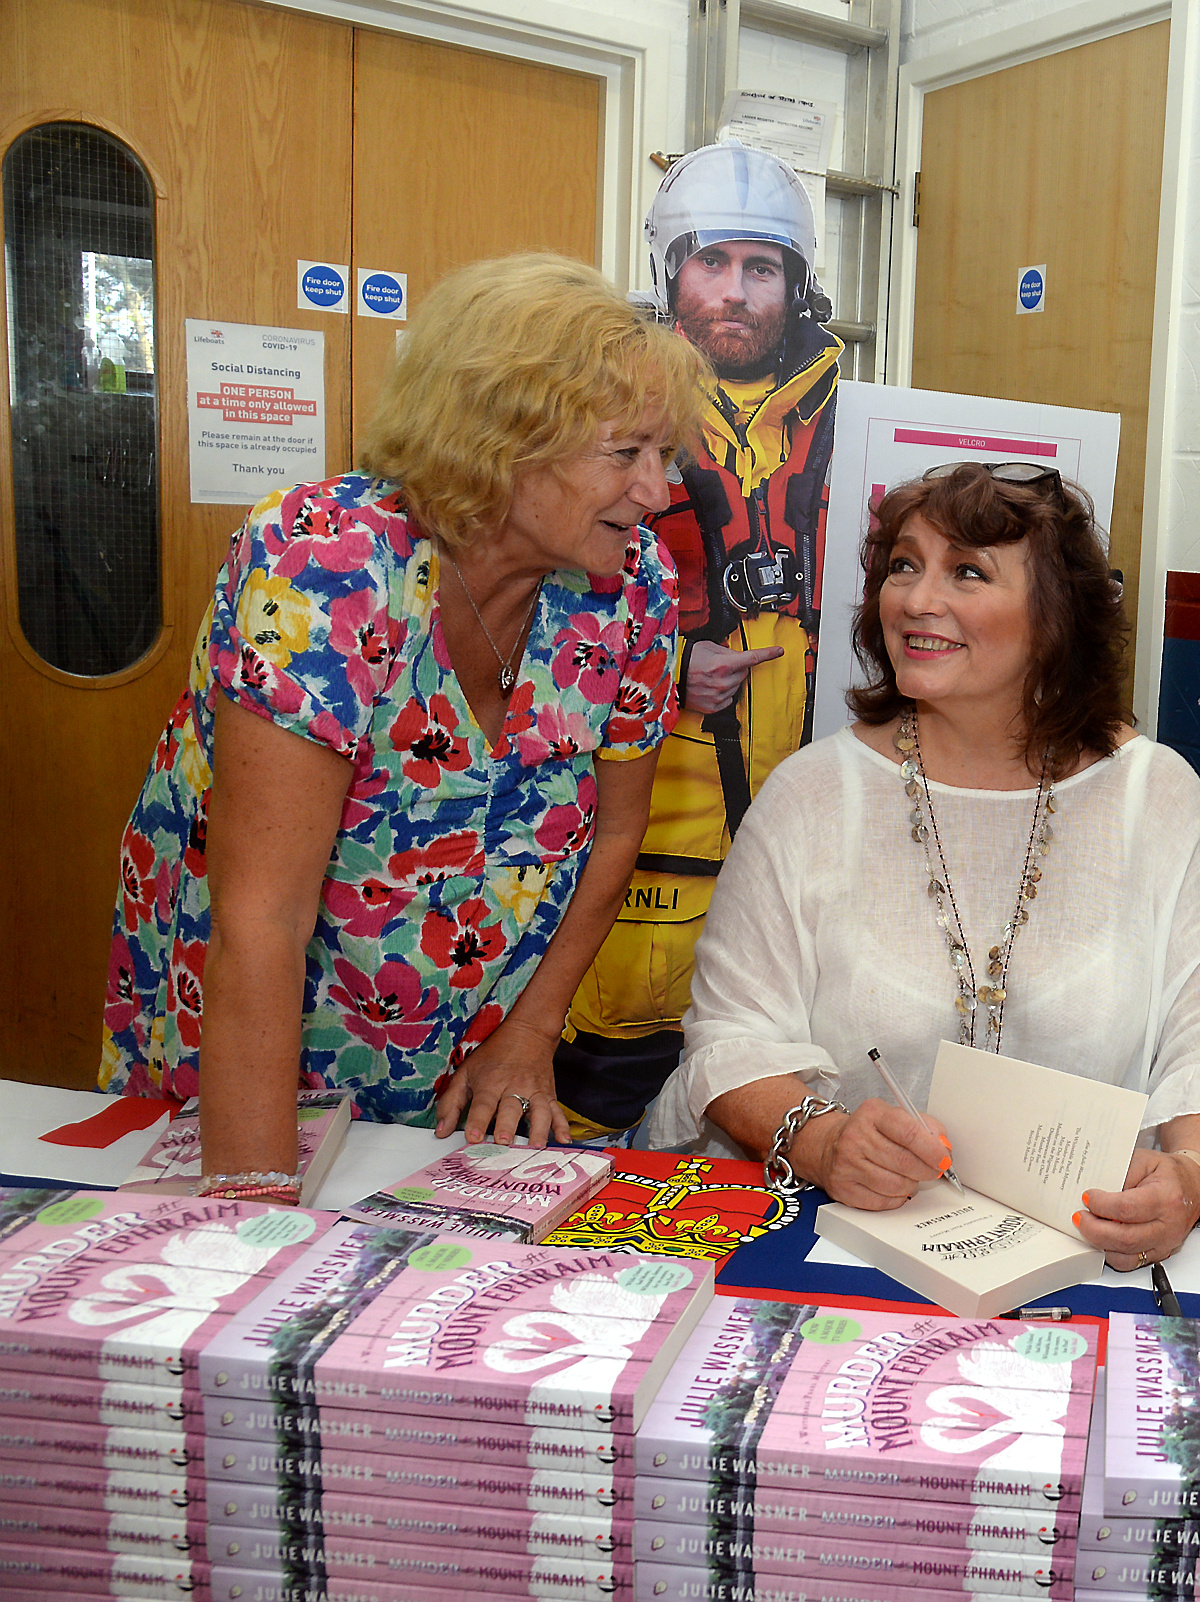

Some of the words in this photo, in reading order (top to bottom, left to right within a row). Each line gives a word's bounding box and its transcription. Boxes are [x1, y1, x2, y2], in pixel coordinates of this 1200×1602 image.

[305, 285, 324, 294] keep
[325, 288, 342, 296] shut
[306, 276, 321, 285] Fire
[322, 278, 341, 287] door
[366, 284, 381, 293] Fire
[381, 286, 399, 295] door
[365, 292, 383, 302] keep
[384, 295, 401, 304] shut
[194, 336, 225, 345] Lifeboats
[262, 334, 316, 346] CORONAVIRUS
[262, 342, 298, 351] COVID-19
[211, 362, 244, 373] Social
[247, 365, 301, 379] Distancing
[223, 386, 246, 397] ONE
[248, 388, 292, 399] PERSON
[200, 396, 211, 405] at
[213, 398, 220, 406] a
[222, 397, 246, 407] time
[248, 400, 271, 412] only
[273, 401, 315, 412] allowed
[225, 409, 236, 418] in
[238, 410, 258, 420] this
[260, 413, 291, 423] space
[202, 431, 230, 439] Please
[232, 434, 261, 442] remain
[272, 435, 286, 443] the
[287, 436, 306, 444] door
[958, 438, 986, 447] VELCRO
[197, 440, 214, 448] this
[216, 442, 239, 450] space
[250, 444, 281, 453] already
[282, 446, 317, 454] occupied
[232, 463, 264, 474] Thank
[267, 467, 285, 476] you
[441, 1157, 492, 1187] EPHRAIM
[431, 1176, 552, 1208] MURDER
[485, 1178, 561, 1196] MOUNT
[359, 1204, 446, 1230] WASSMER
[951, 1205, 975, 1217] JULIE
[914, 1213, 953, 1229] WASSMER
[987, 1214, 1025, 1240] MOUNT
[445, 1226, 502, 1240] JULIE
[922, 1234, 992, 1253] EPHRAIM
[17, 1253, 108, 1323] MOUNT
[94, 1202, 242, 1254] EPHRAIM
[242, 1299, 308, 1347] JULIE
[290, 1232, 377, 1296] WASSMER
[383, 1260, 524, 1369] MURDER
[435, 1299, 501, 1372] MOUNT
[486, 1254, 615, 1303] EPHRAIM
[890, 1320, 1005, 1376] EPHRAIM
[675, 1375, 723, 1428] JULIE
[701, 1306, 760, 1371] WASSMER
[1135, 1324, 1163, 1399] WASSMER
[239, 1372, 287, 1391] JULIE
[291, 1378, 368, 1398] WASSMER
[380, 1387, 454, 1407] MURDER
[472, 1397, 520, 1412] MOUNT
[523, 1401, 583, 1418] EPHRAIM
[820, 1331, 921, 1450] MURDER
[871, 1375, 918, 1452] MOUNT
[1135, 1404, 1169, 1462] JULIE
[679, 1454, 728, 1471] JULIE
[732, 1459, 811, 1478] WASSMER
[823, 1468, 900, 1486] MURDER
[919, 1476, 967, 1491] MOUNT
[970, 1478, 1031, 1496] EPHRAIM
[1149, 1490, 1199, 1507] JULIE
[677, 1496, 725, 1514] JULIE
[730, 1501, 808, 1521] WASSMER
[821, 1511, 896, 1530] MURDER
[915, 1520, 963, 1535] MOUNT
[966, 1523, 1026, 1540] EPHRAIM
[1122, 1526, 1172, 1544] JULIE
[676, 1538, 724, 1556] JULIE
[729, 1543, 806, 1563] WASSMER
[818, 1552, 894, 1571] MURDER
[912, 1561, 960, 1577] MOUNT
[963, 1564, 1022, 1582] EPHRAIM
[1118, 1567, 1166, 1584] JULIE
